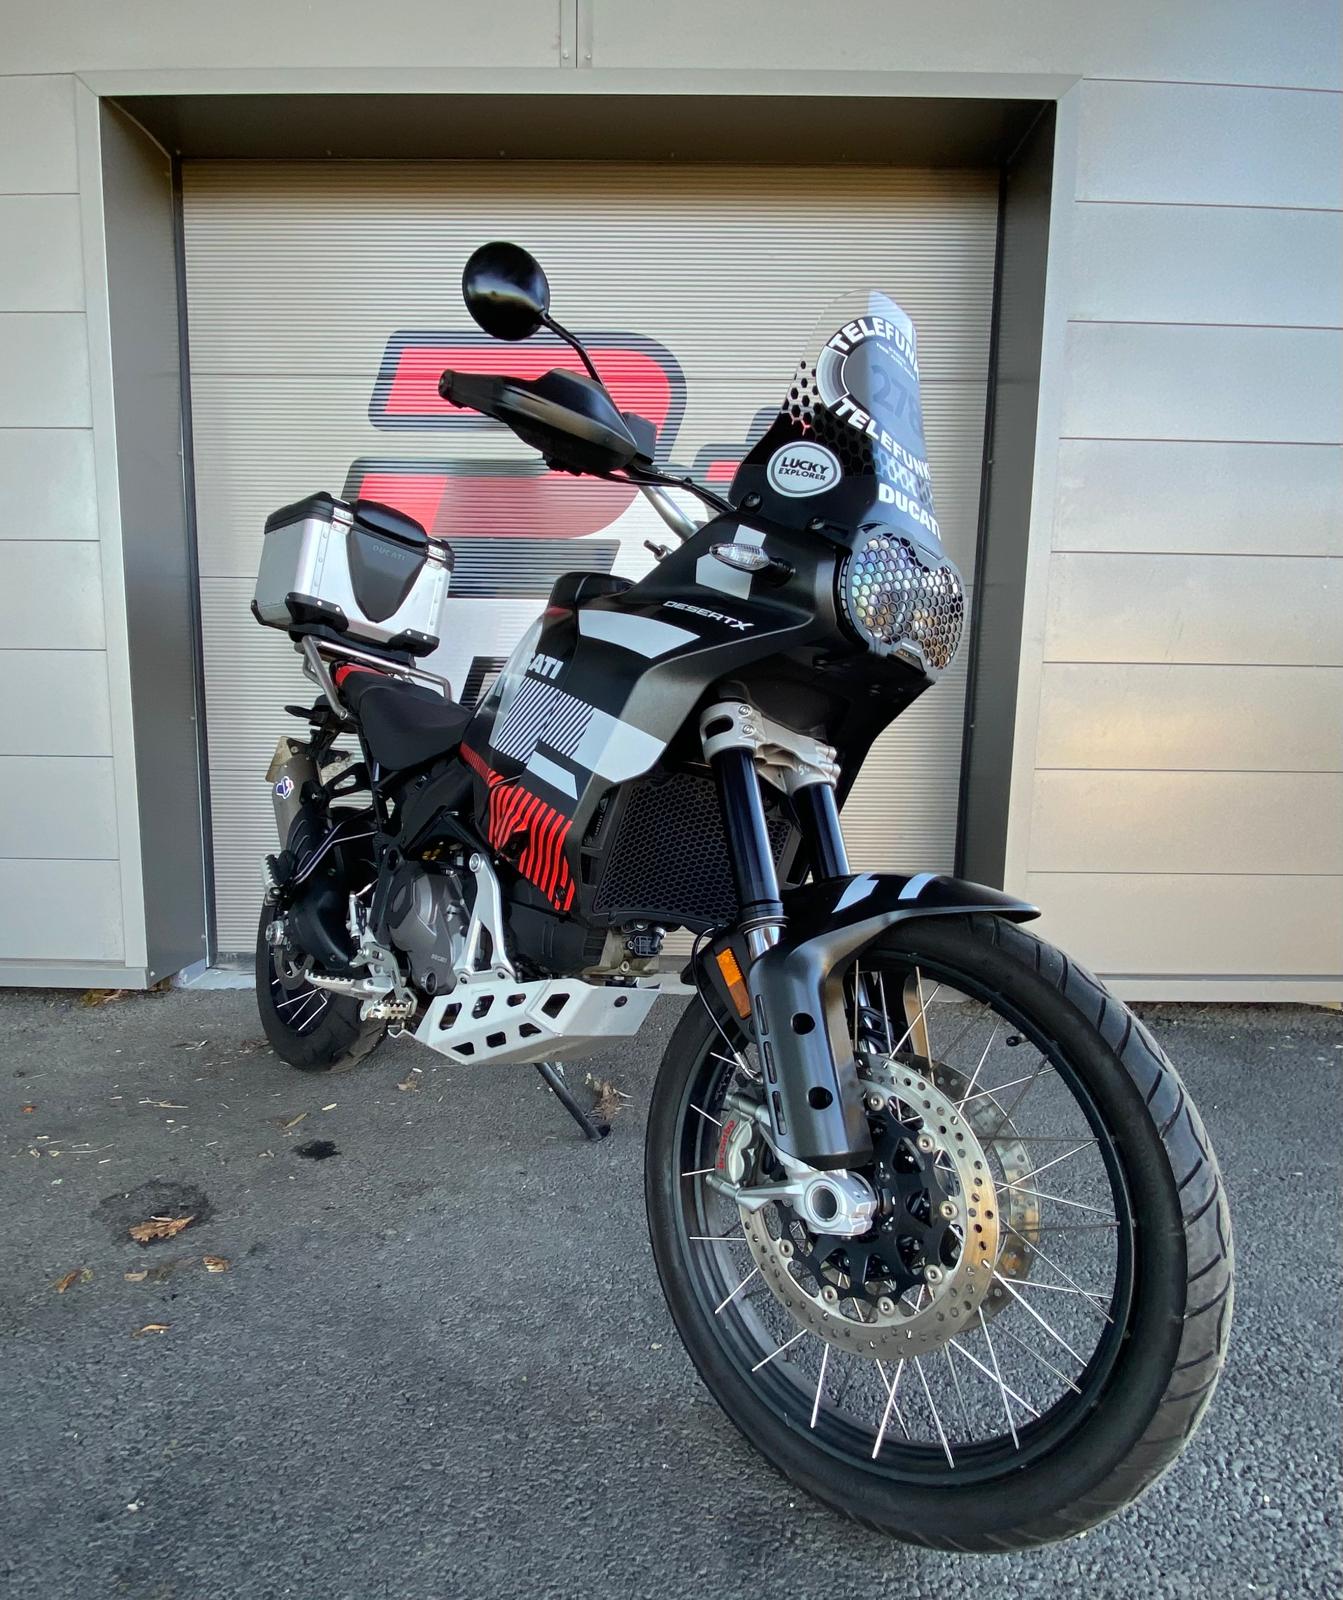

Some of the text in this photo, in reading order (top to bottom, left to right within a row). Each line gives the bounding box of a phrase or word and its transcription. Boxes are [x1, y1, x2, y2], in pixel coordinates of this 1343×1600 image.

[781, 457, 829, 474] LUCKY
[778, 467, 826, 481] EXPLORER
[372, 544, 407, 560] DUCATI
[663, 601, 755, 630] DESERTX
